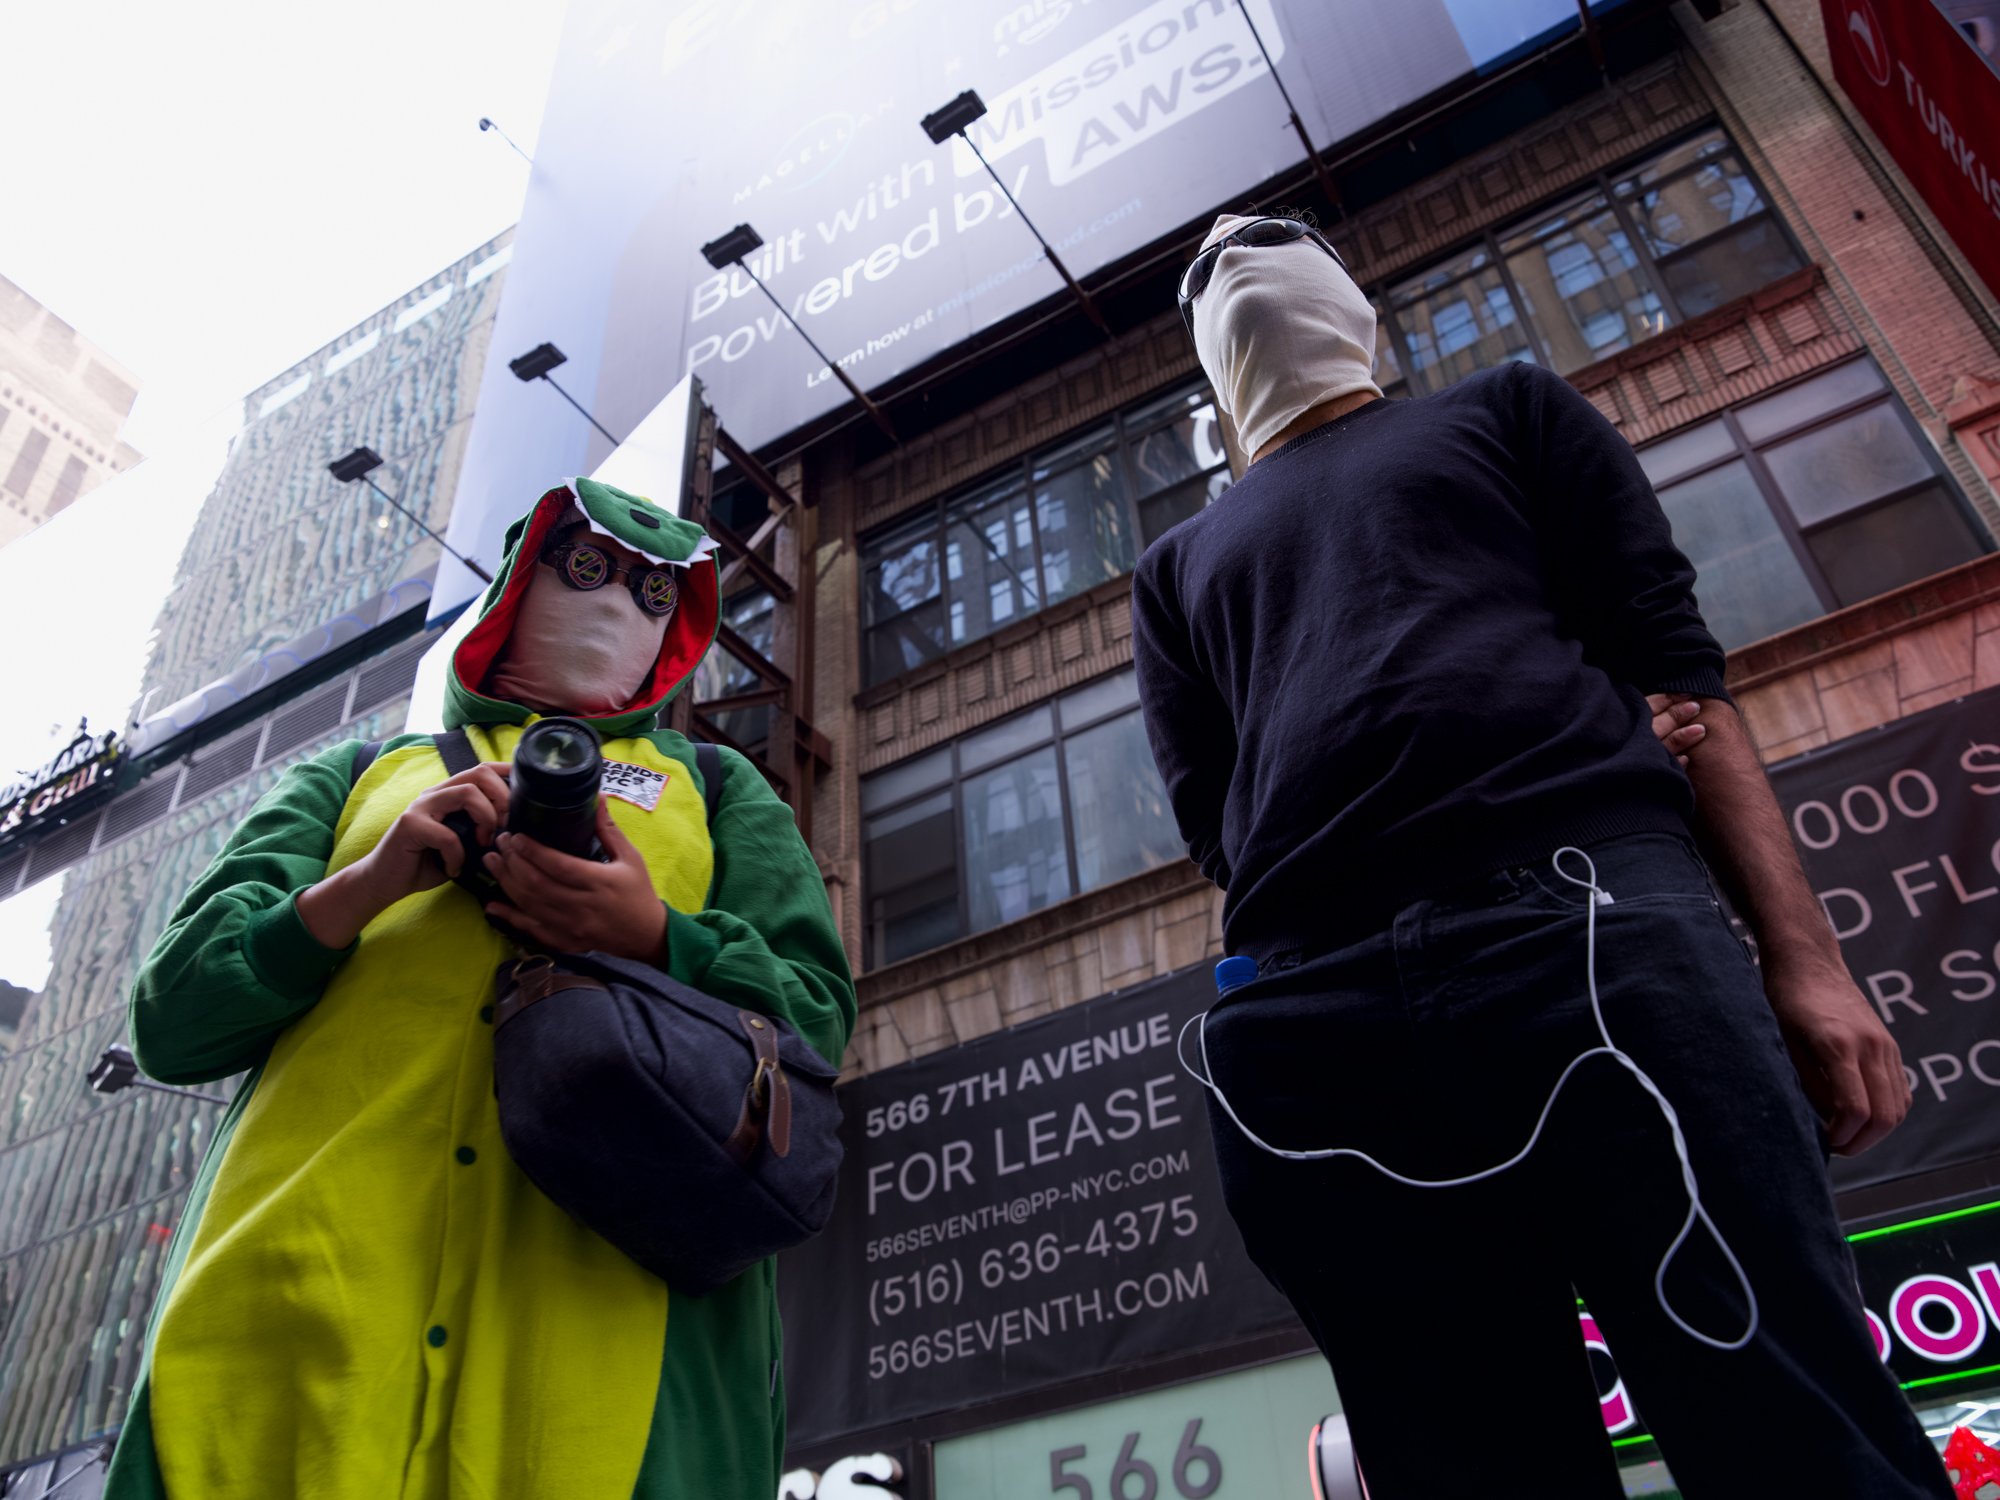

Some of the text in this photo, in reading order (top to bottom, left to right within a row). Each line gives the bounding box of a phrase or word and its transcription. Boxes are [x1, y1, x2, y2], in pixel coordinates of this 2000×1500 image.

[686, 42, 1262, 375] Powered by AWS.
[731, 96, 895, 206] MAGELLAN
[690, 226, 807, 323] Built
[816, 158, 935, 245] with
[807, 196, 1144, 389] Lern how at missionclud.com
[29, 761, 100, 816] Grill
[866, 1013, 1172, 1138] 566 7TH AVENUE
[866, 1150, 1190, 1263] 566SEVENTH@PP-NYC.COM
[867, 1073, 1182, 1215] FOR LEASE
[868, 1261, 1210, 1380] 566SEVENTH.COM
[869, 1194, 1199, 1326] (516) 636-4375
[1048, 1417, 1223, 1500] 566
